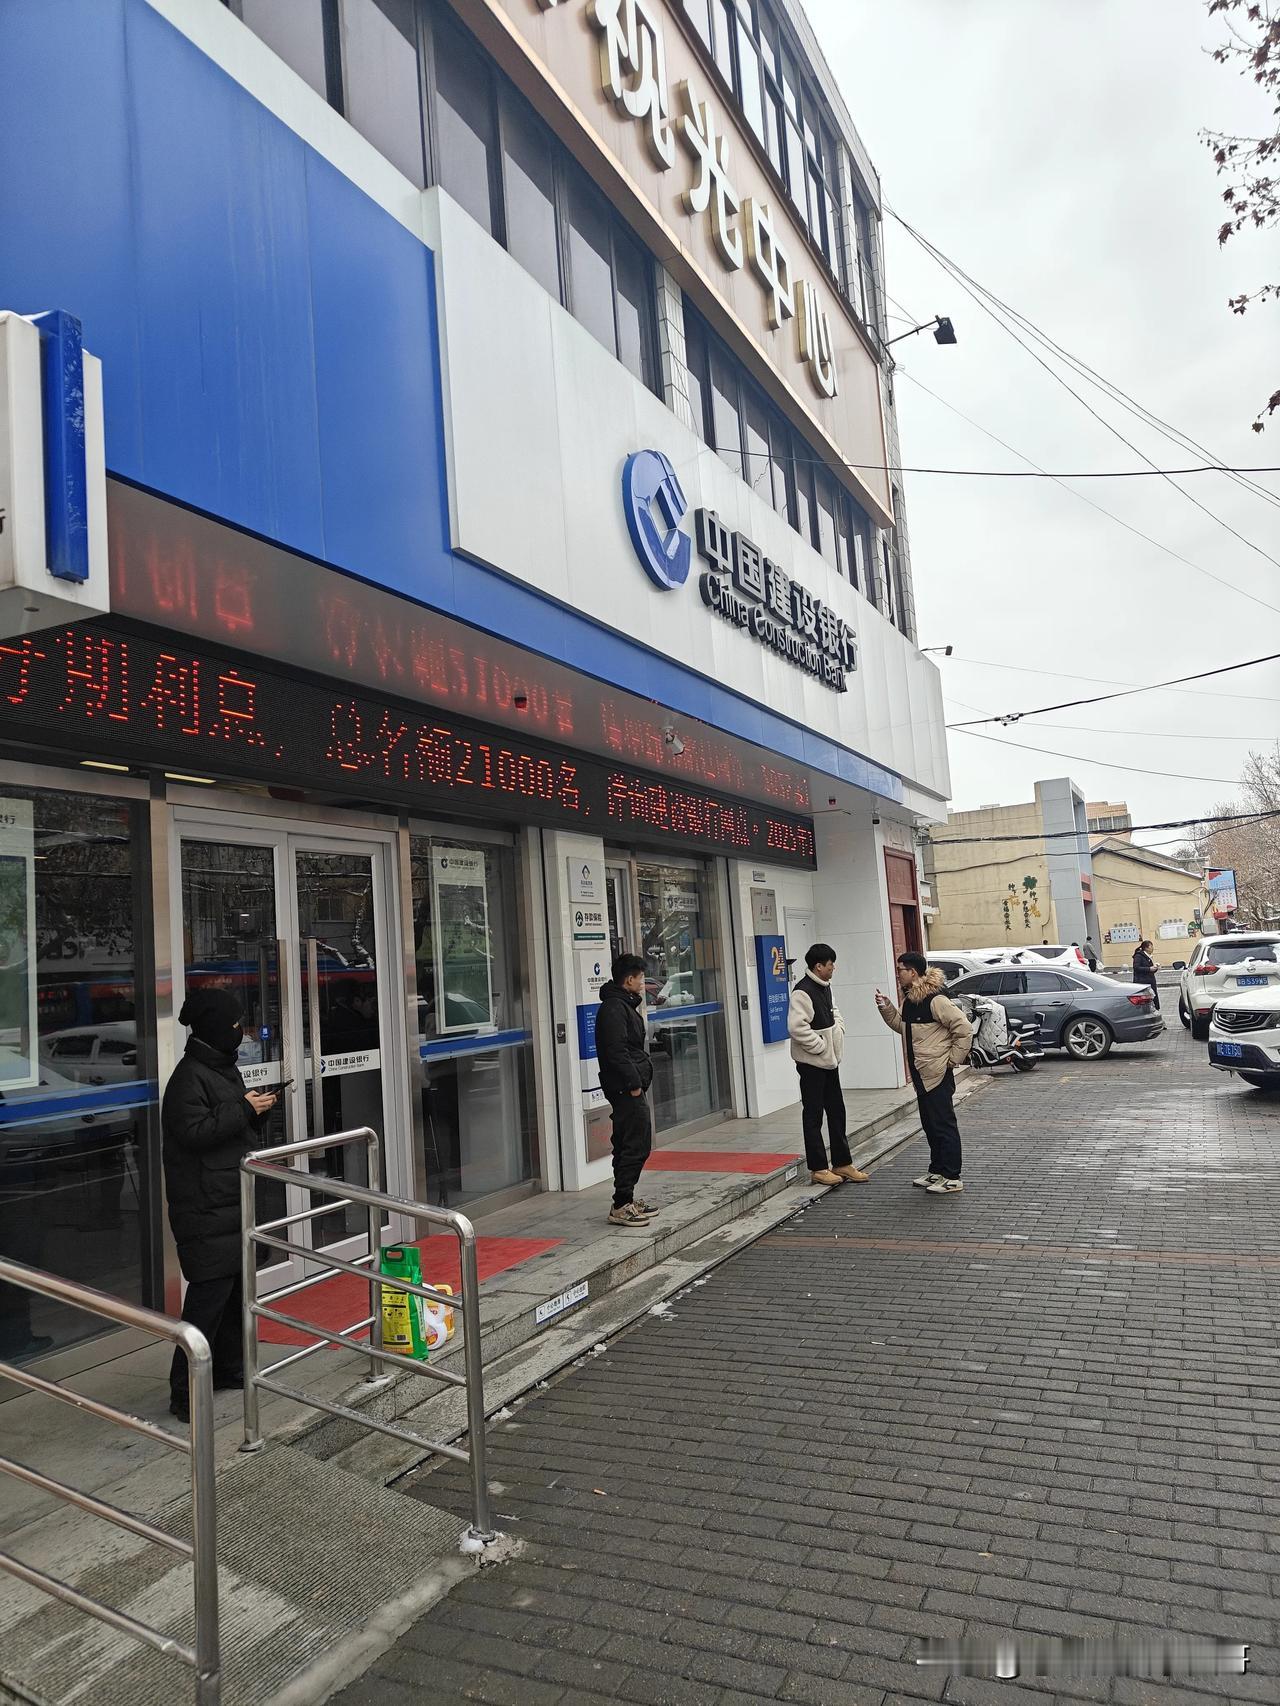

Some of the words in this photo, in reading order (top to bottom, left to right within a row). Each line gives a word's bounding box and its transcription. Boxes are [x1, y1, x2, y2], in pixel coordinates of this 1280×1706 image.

[695, 507, 859, 672] 中国建设银行
[699, 571, 750, 630] China
[747, 605, 824, 681] Construction
[821, 655, 848, 693] Bank
[327, 1054, 370, 1067] 中国建设银行
